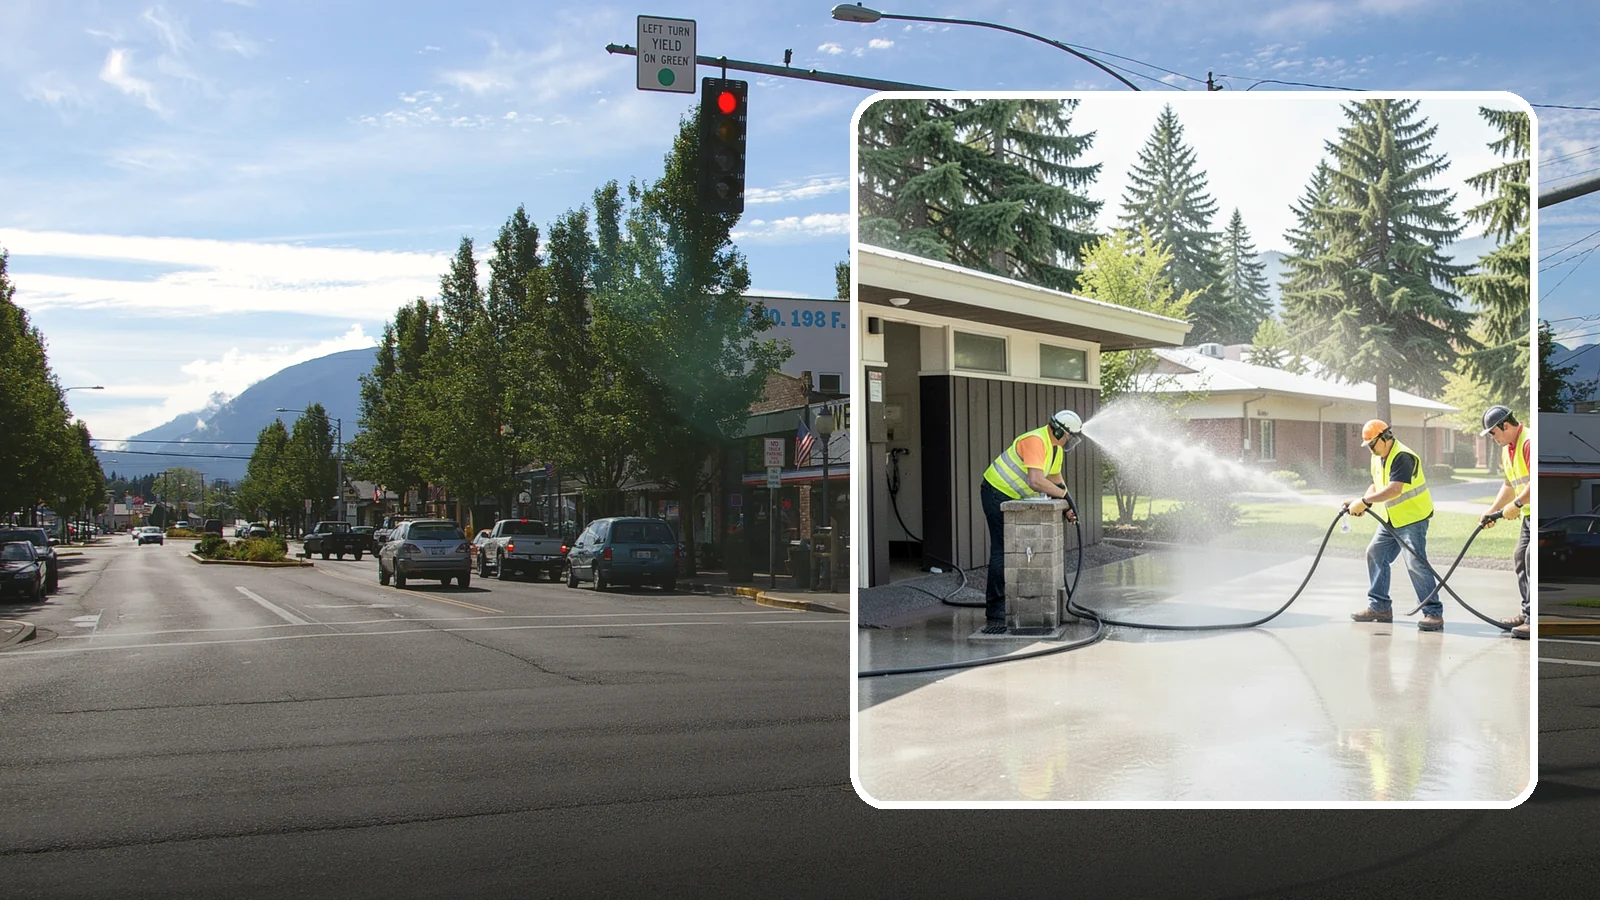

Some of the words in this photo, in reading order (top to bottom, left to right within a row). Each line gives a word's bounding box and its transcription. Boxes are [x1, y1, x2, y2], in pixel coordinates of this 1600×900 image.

[643, 24, 662, 34] LEFT
[668, 25, 690, 36] TURN
[652, 38, 682, 51] YIELD
[644, 53, 656, 64] ON
[661, 55, 688, 66] GREEN
[791, 309, 826, 328] 198
[831, 311, 847, 329] F.
